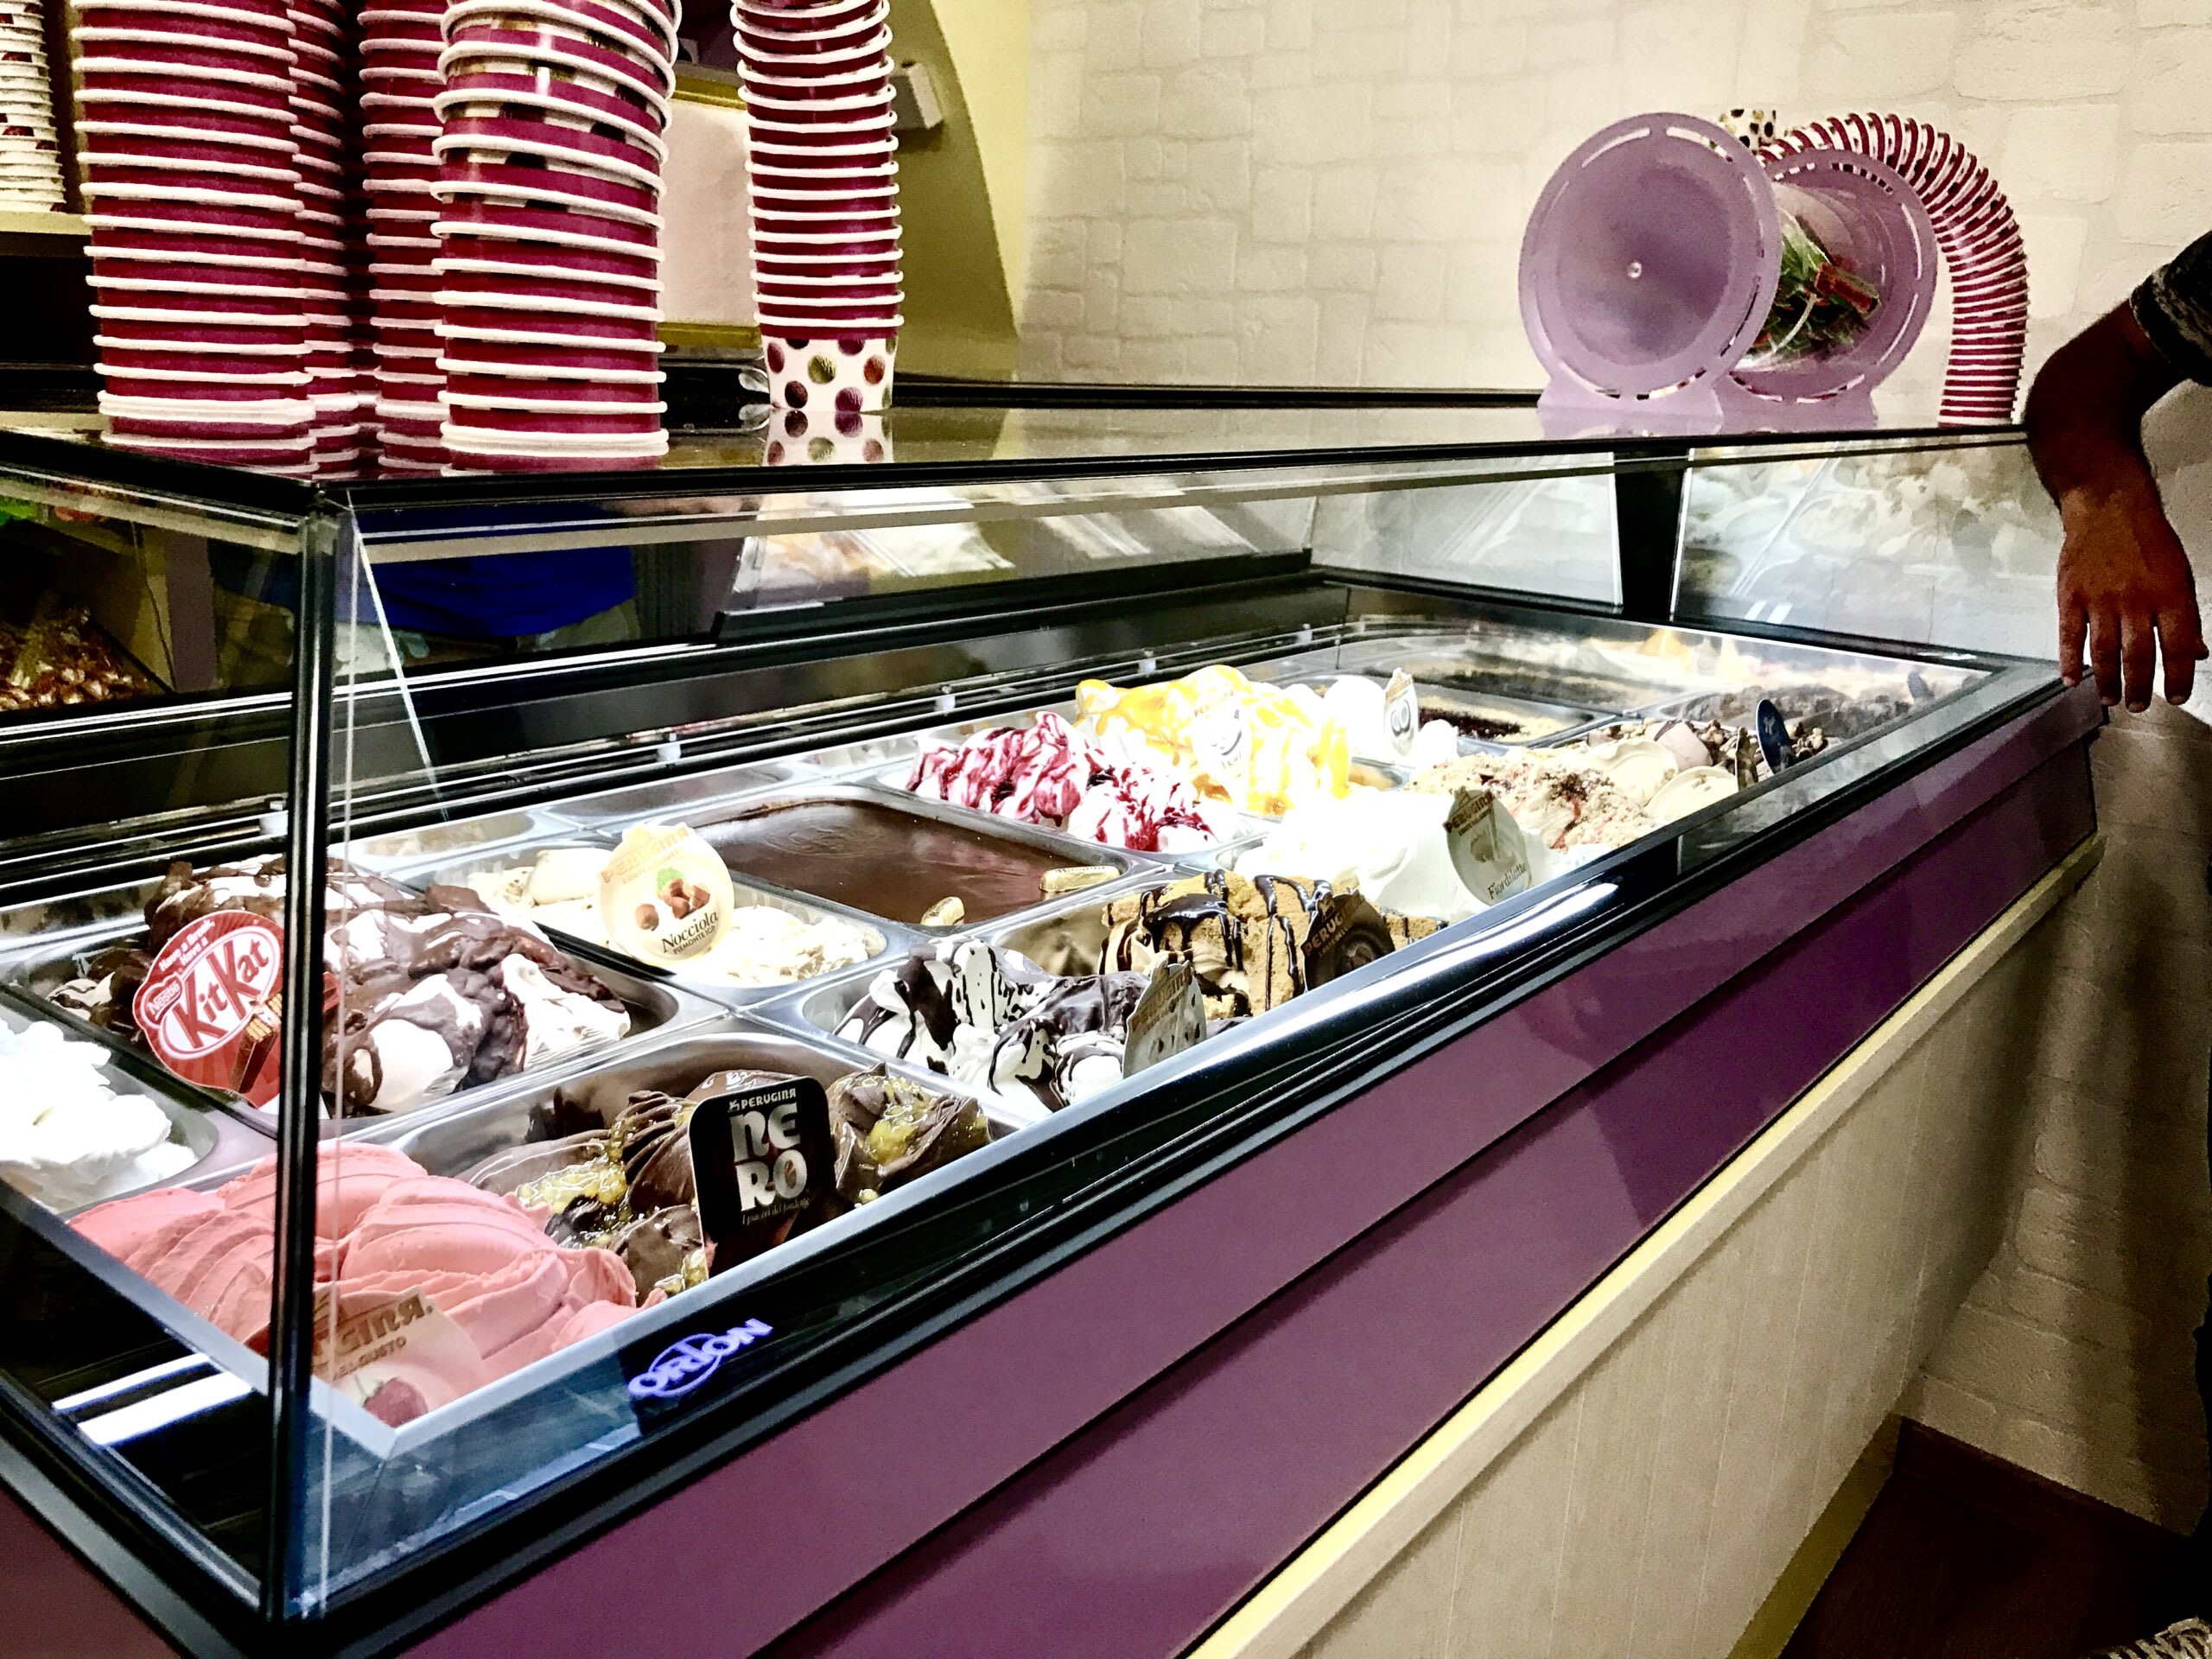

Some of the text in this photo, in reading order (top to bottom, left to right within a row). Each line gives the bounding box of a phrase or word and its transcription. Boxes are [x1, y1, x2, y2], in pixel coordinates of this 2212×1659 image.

[660, 910, 719, 954] Nocciola
[672, 925, 716, 955] PIEMONTE IGP
[181, 946, 200, 966] Have
[741, 1087, 797, 1110] PERUGINA
[628, 1318, 774, 1397] ORION
